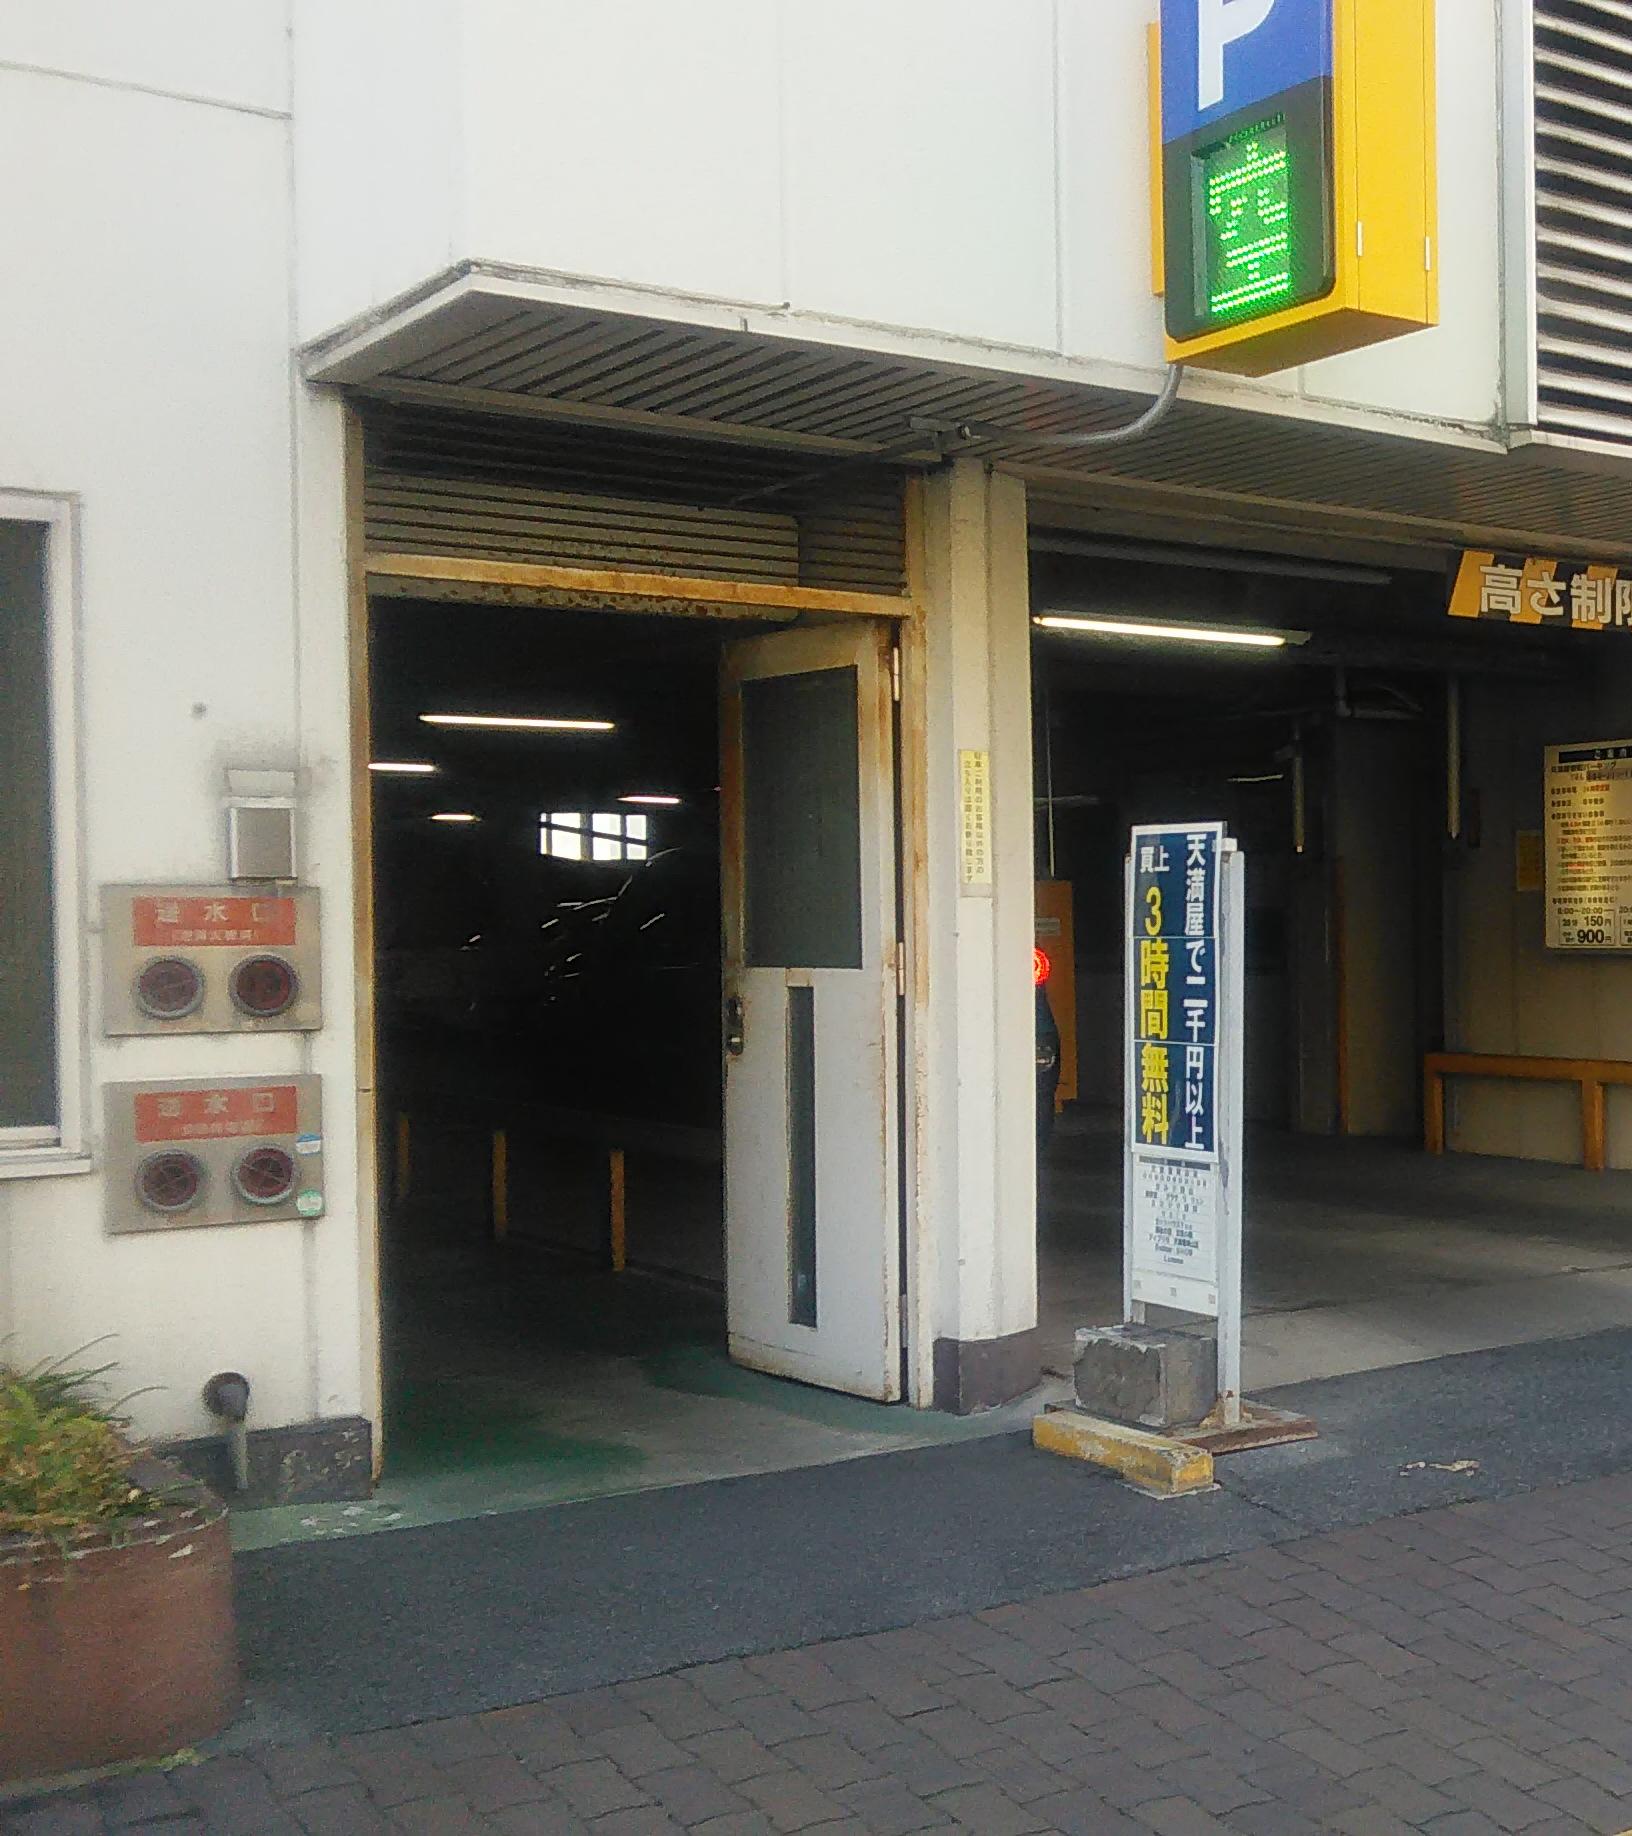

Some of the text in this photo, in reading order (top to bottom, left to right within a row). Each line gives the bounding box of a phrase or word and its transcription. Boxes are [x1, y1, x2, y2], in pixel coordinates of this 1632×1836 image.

[1198, 0, 1275, 111] P
[1209, 143, 1288, 313] 空
[1139, 886, 1170, 1145] 3時間無料
